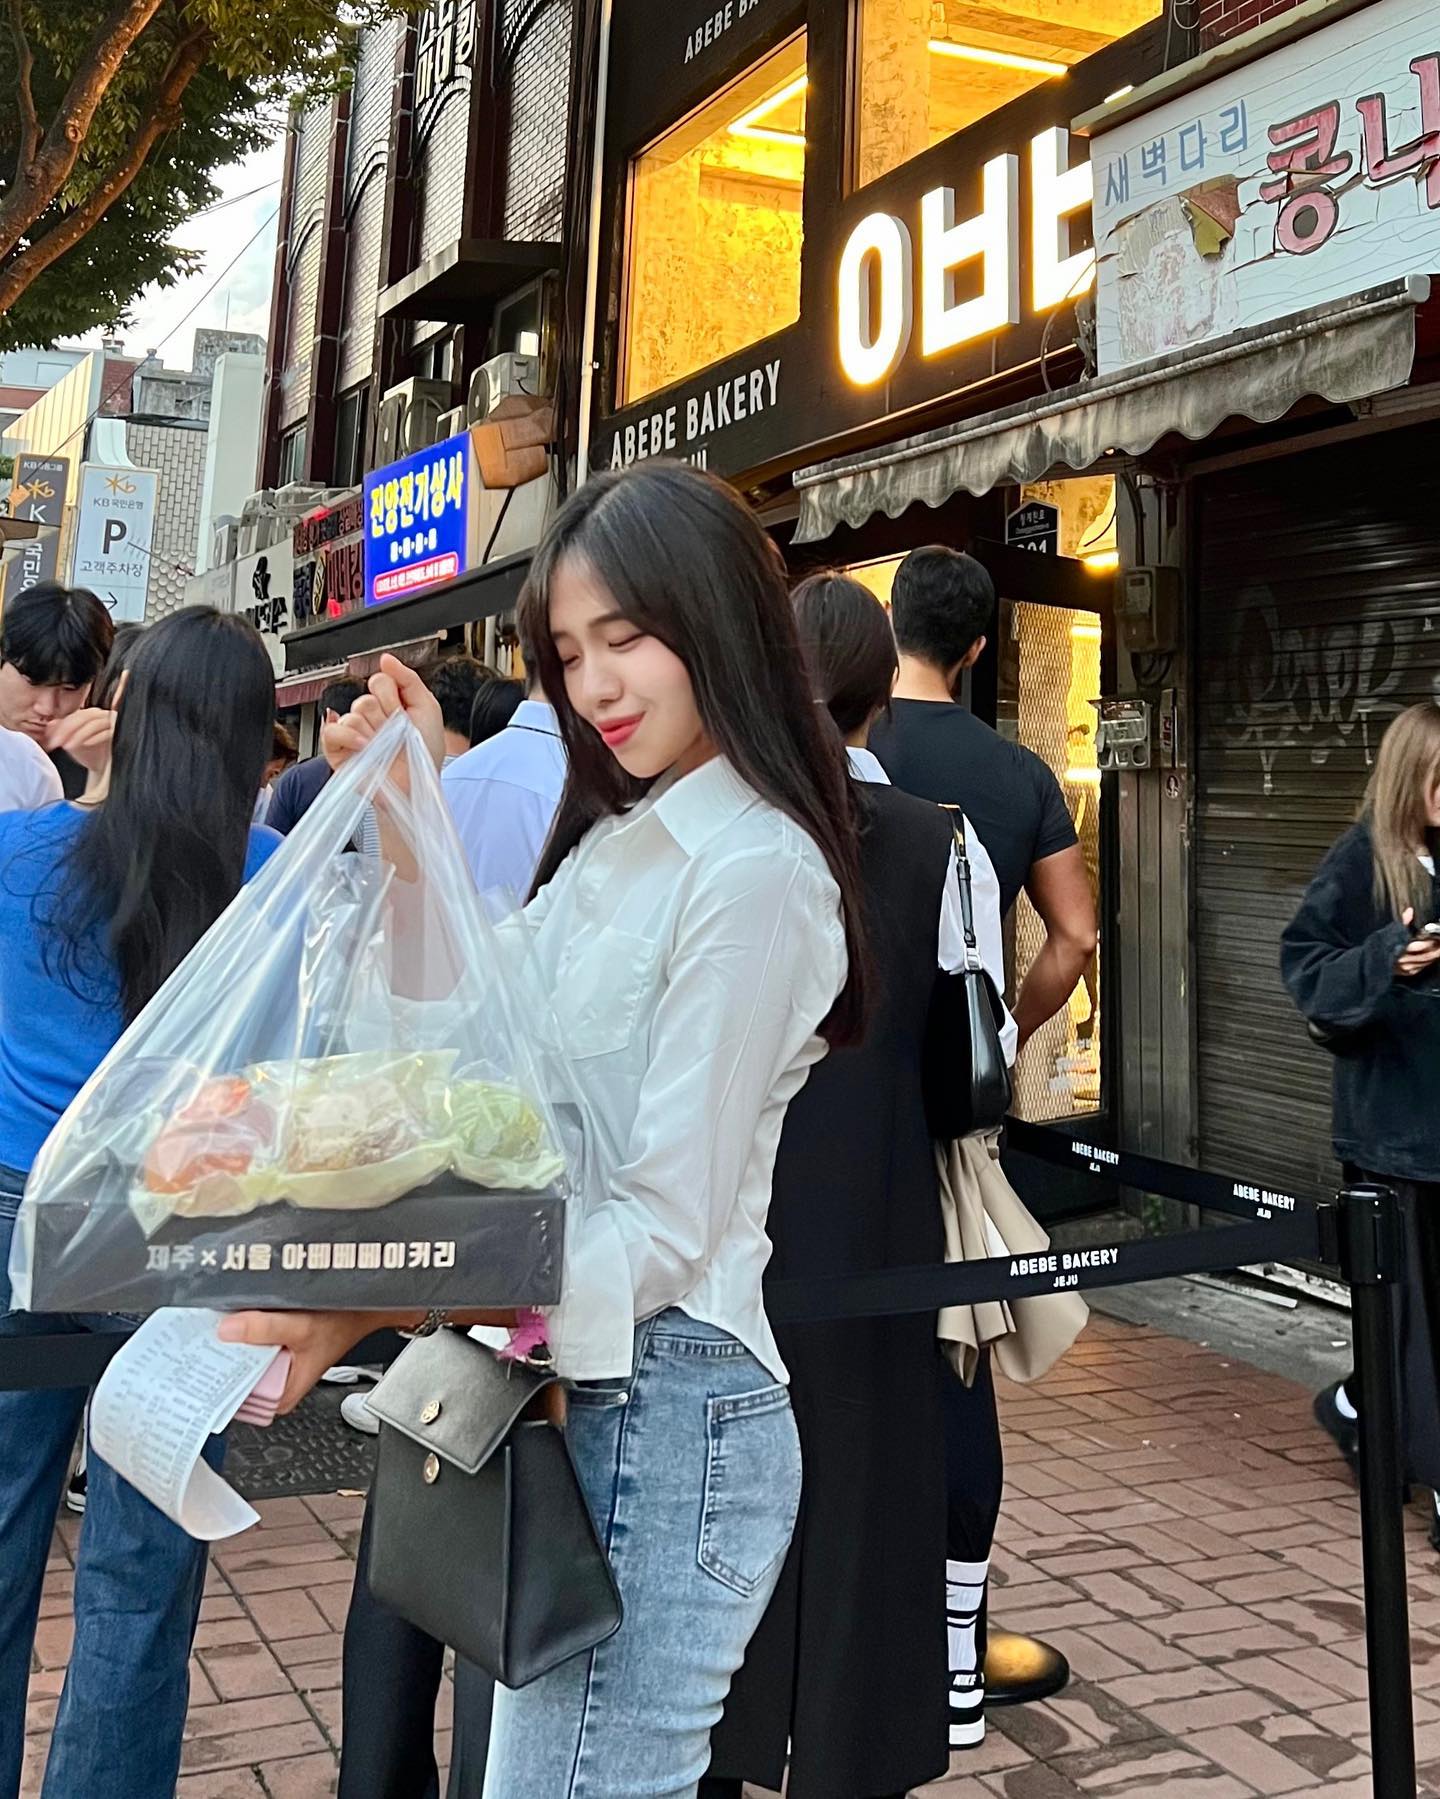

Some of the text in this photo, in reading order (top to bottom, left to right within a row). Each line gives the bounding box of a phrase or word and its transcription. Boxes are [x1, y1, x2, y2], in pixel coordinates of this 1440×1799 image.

[684, 1, 733, 64] ABEBE
[1105, 99, 1248, 206] 새벽다리
[611, 359, 781, 472] ABEBE BAKERY
[93, 497, 110, 507] KB
[370, 450, 464, 538] 진양전기상사
[102, 519, 127, 555] P
[80, 560, 144, 577] 고객주차장
[1233, 1183, 1295, 1211] ABEBE BAKERY
[146, 1244, 195, 1271] 제주
[221, 1243, 272, 1271] 서울
[281, 1240, 456, 1270] 아베베베이커리
[1009, 1248, 1119, 1277] ABEBE BAKERY
[1053, 1274, 1079, 1288] JEJU
